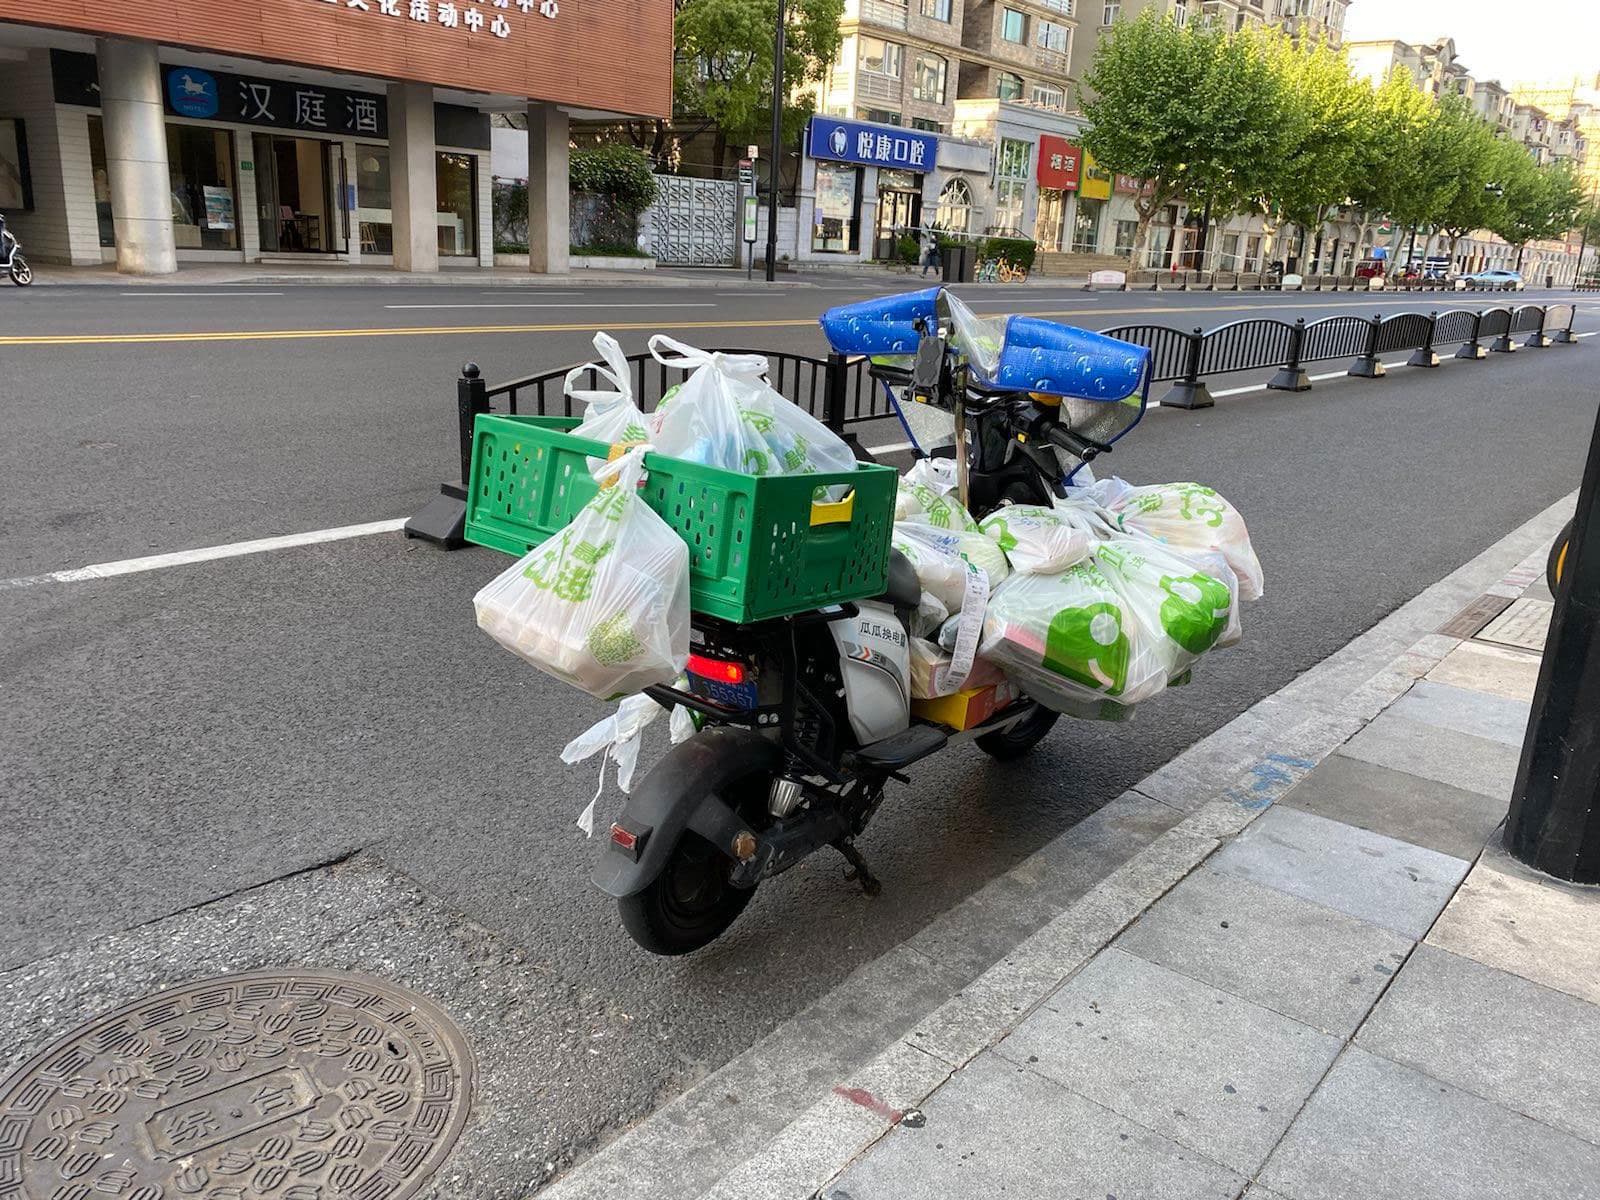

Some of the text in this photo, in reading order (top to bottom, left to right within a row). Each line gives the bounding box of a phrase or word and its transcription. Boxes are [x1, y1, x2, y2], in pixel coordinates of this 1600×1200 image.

[239, 80, 378, 133] 汉庭酒
[857, 131, 925, 166] 悦康口腔
